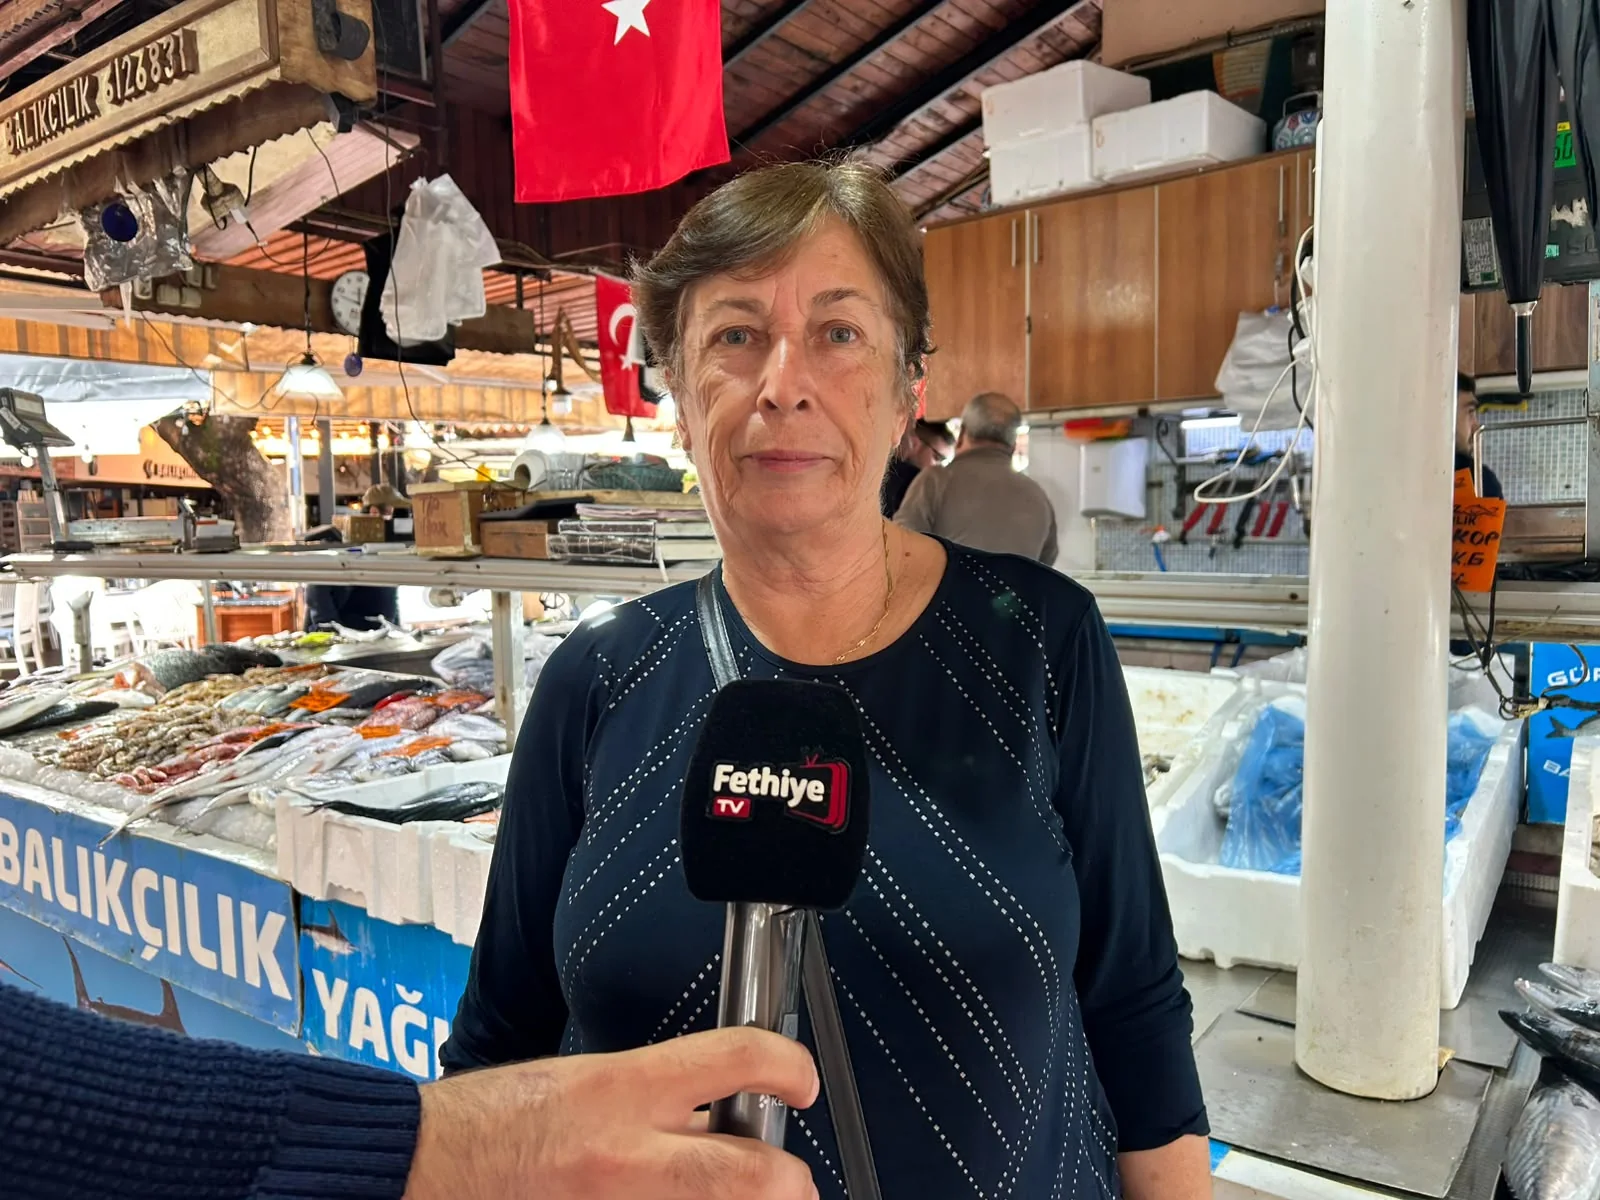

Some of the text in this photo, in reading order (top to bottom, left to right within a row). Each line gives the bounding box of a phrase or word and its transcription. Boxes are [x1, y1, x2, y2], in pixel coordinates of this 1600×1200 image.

[713, 764, 826, 808] Fethiye
[717, 798, 745, 815] TV
[0, 816, 293, 1001] BALIKÇILIK
